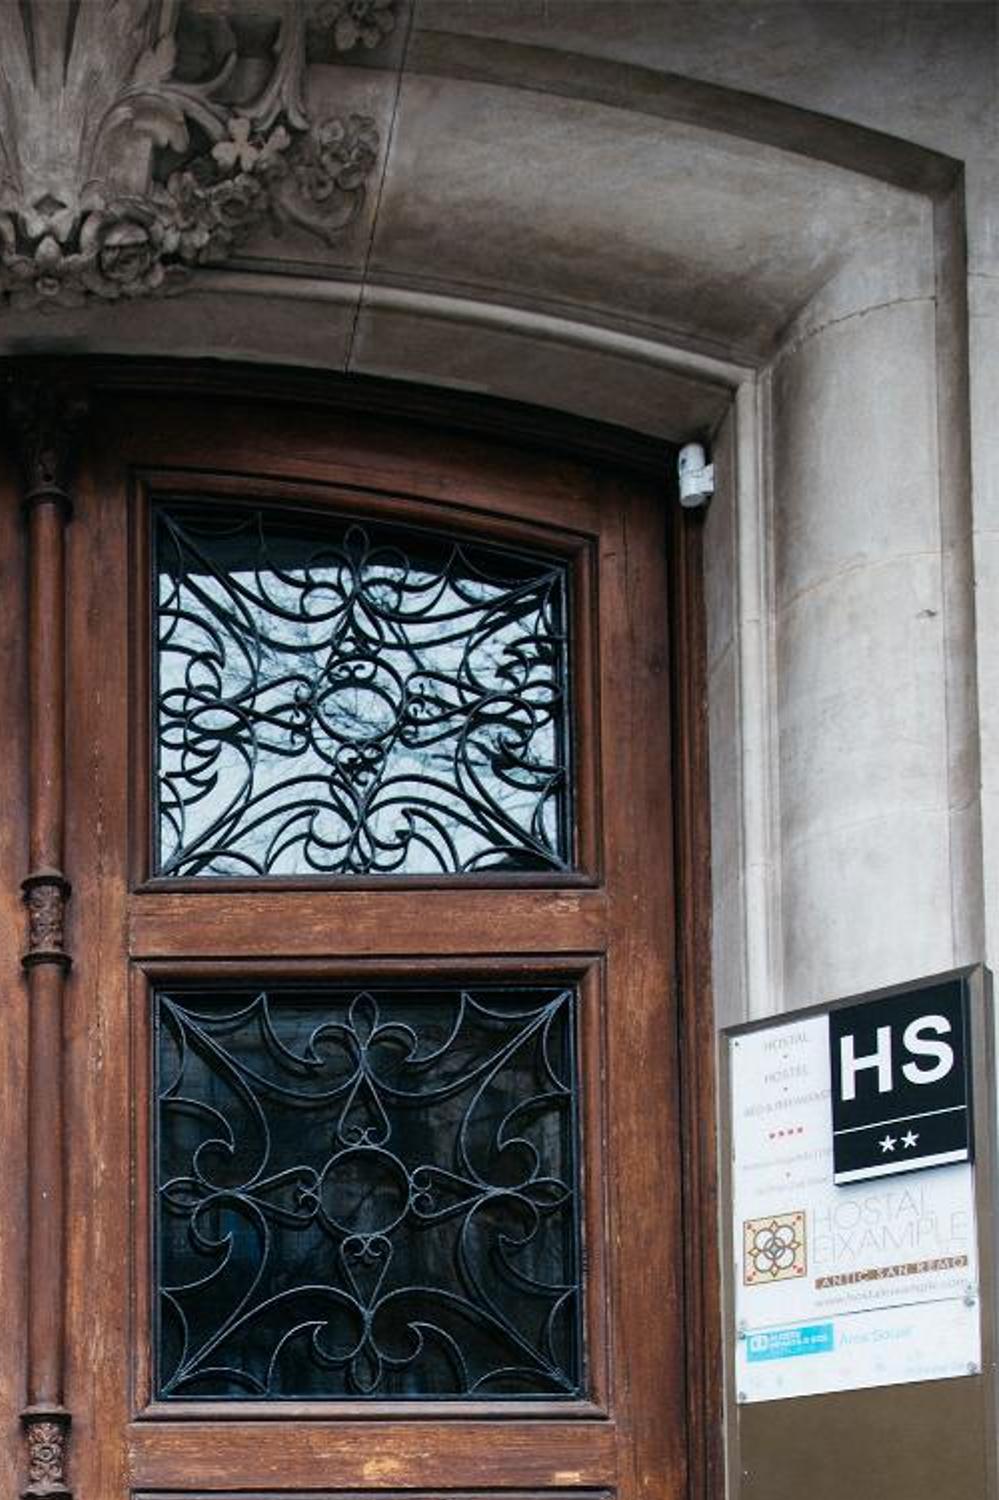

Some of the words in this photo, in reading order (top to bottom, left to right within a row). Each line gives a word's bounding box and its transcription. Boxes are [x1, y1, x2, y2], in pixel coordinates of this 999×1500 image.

[839, 1013, 955, 1101] HS
[812, 1185, 935, 1233] HOSTAL
[812, 1210, 968, 1265] EIXAMPLE
